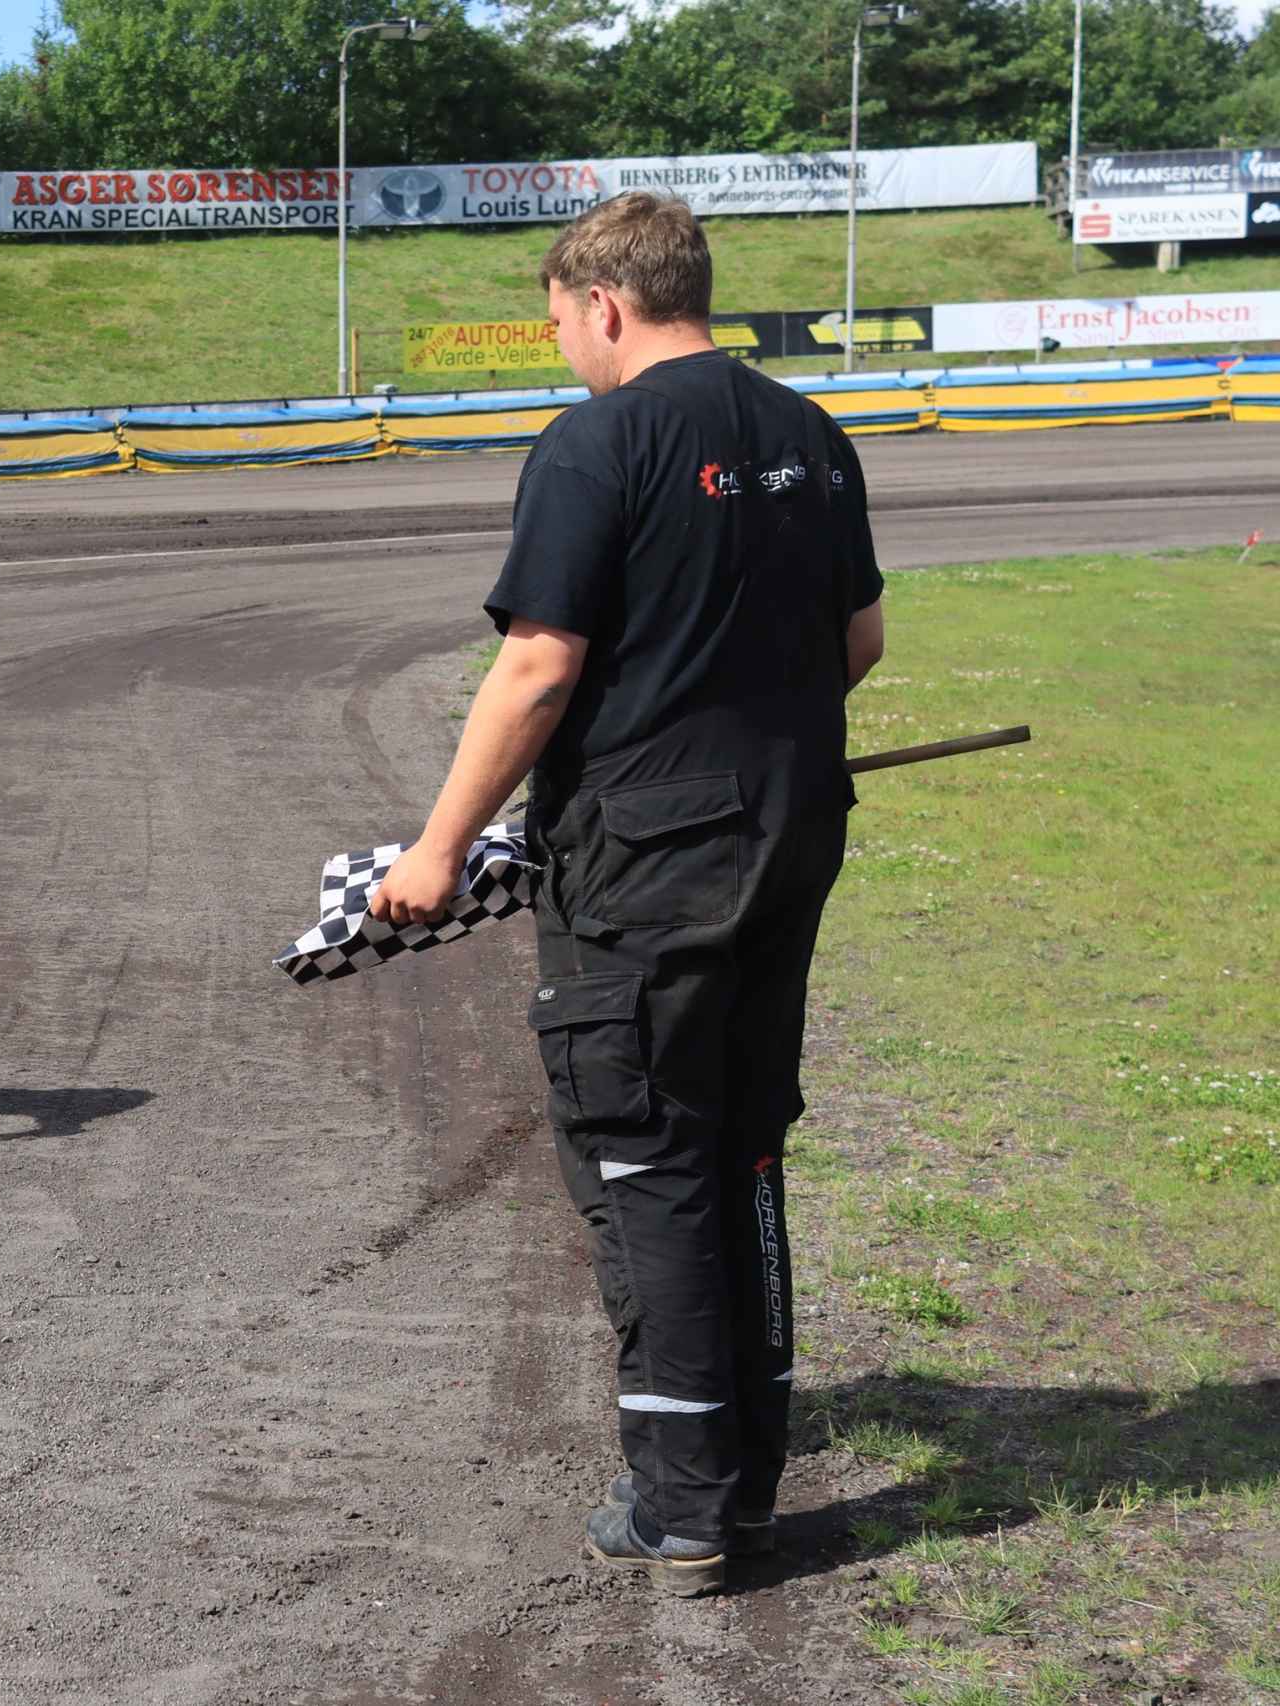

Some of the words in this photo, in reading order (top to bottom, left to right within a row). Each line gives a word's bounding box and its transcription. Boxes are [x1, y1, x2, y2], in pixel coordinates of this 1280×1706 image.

[12, 174, 140, 206] ASGER
[147, 170, 353, 204] SØRENSEN
[462, 164, 601, 194] TOYOTA
[619, 166, 720, 187] HENNEBERG
[12, 208, 83, 230] KRAN
[91, 205, 355, 229] SPECIALTRANSPORT
[462, 195, 531, 219] Louis
[1036, 303, 1116, 329] Ernst
[1118, 299, 1251, 341] Jacobsen
[430, 348, 485, 367] Varde
